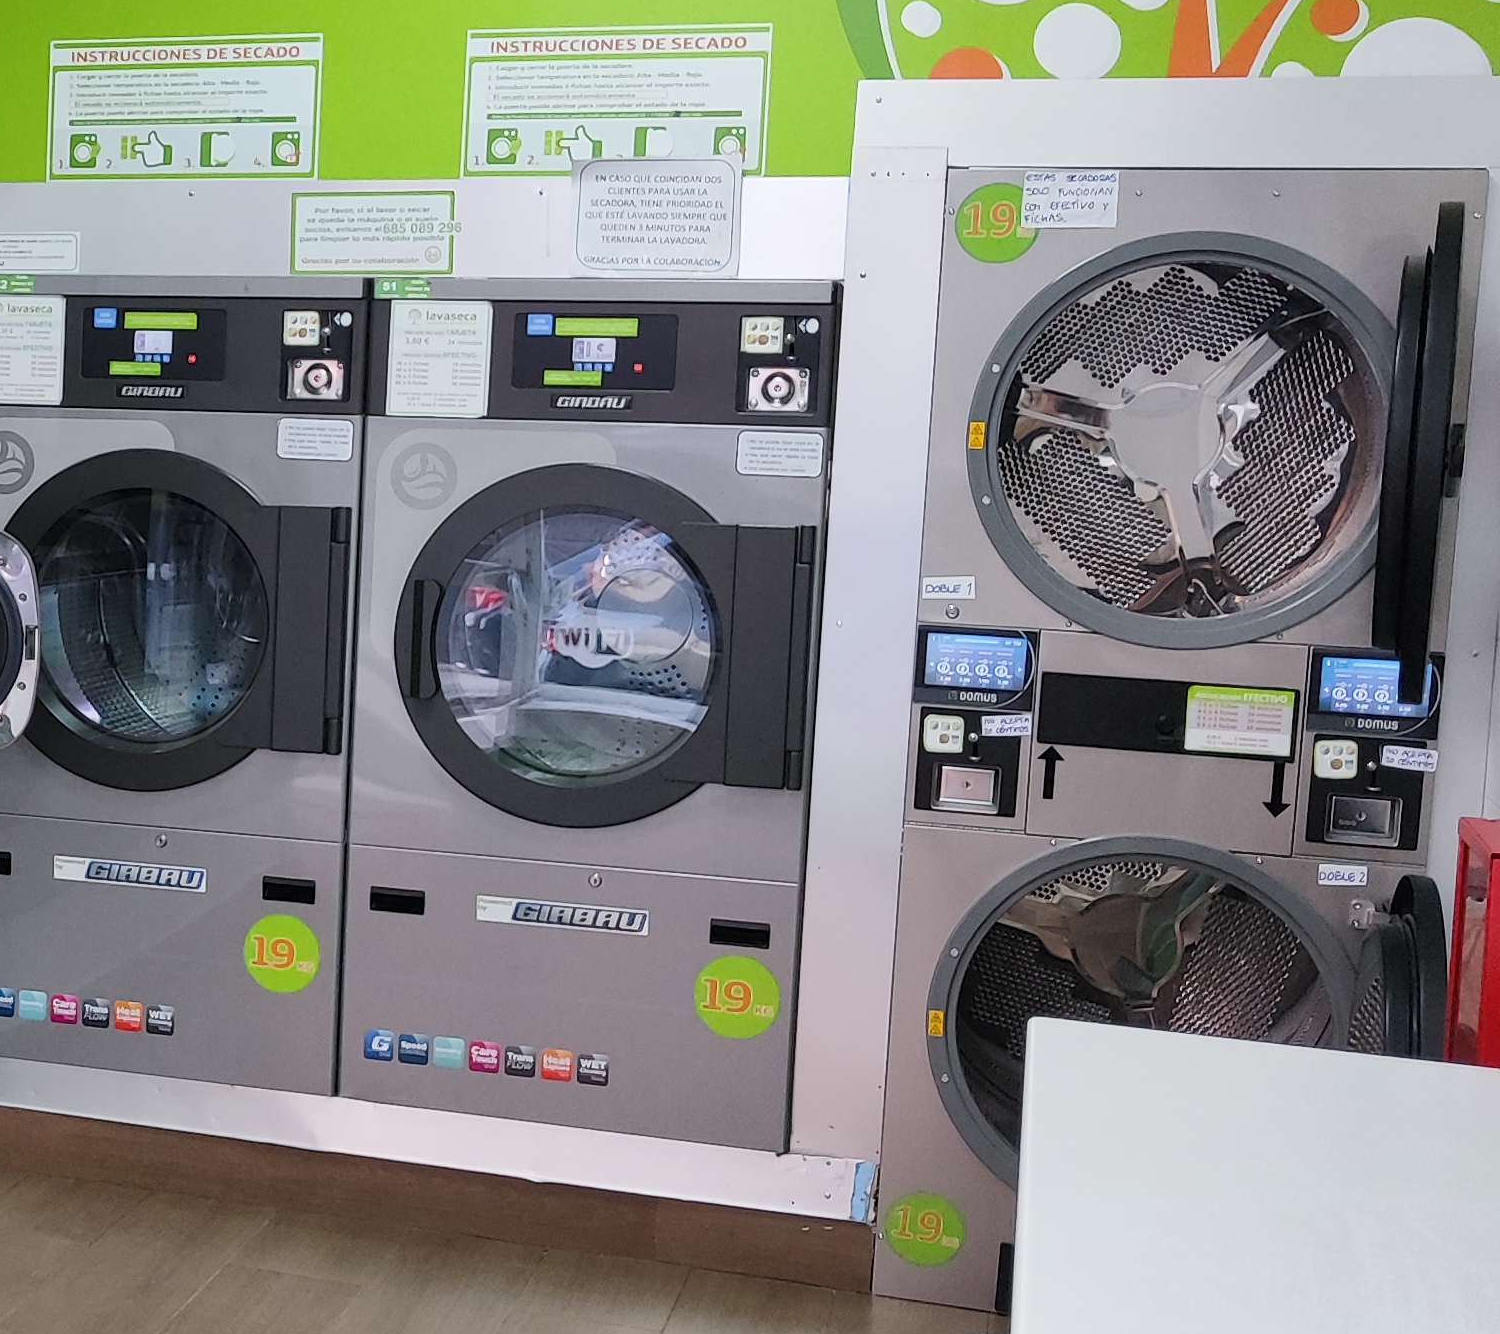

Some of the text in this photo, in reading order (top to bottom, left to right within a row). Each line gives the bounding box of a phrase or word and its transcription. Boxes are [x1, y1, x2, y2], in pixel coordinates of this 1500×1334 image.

[491, 36, 747, 53] INSTRUCCIONES DE SECADO
[71, 45, 300, 63] INSTRUCCIONES DE SECADO
[609, 175, 631, 183] CASO
[634, 175, 651, 183] QUE
[654, 175, 702, 183] COINCIDAN
[704, 176, 722, 184] DOS
[607, 187, 708, 196] CLIENTES PARA USAR LA
[963, 201, 1017, 238] 19
[383, 222, 462, 234] 685 089 296
[600, 224, 636, 232] QUEDEN
[646, 224, 686, 233] MINUTOS
[688, 224, 711, 233] PARA
[601, 235, 645, 244] TERMINAR
[647, 236, 657, 244] LA
[7, 303, 53, 313] lavaseca
[426, 310, 477, 321] lavaseca
[960, 691, 997, 703] DOMUS
[1357, 717, 1399, 731] DOMUS
[1359, 871, 1366, 883] 2
[251, 934, 296, 968] 19
[701, 978, 754, 1014] 19
[892, 1205, 944, 1243] 19
